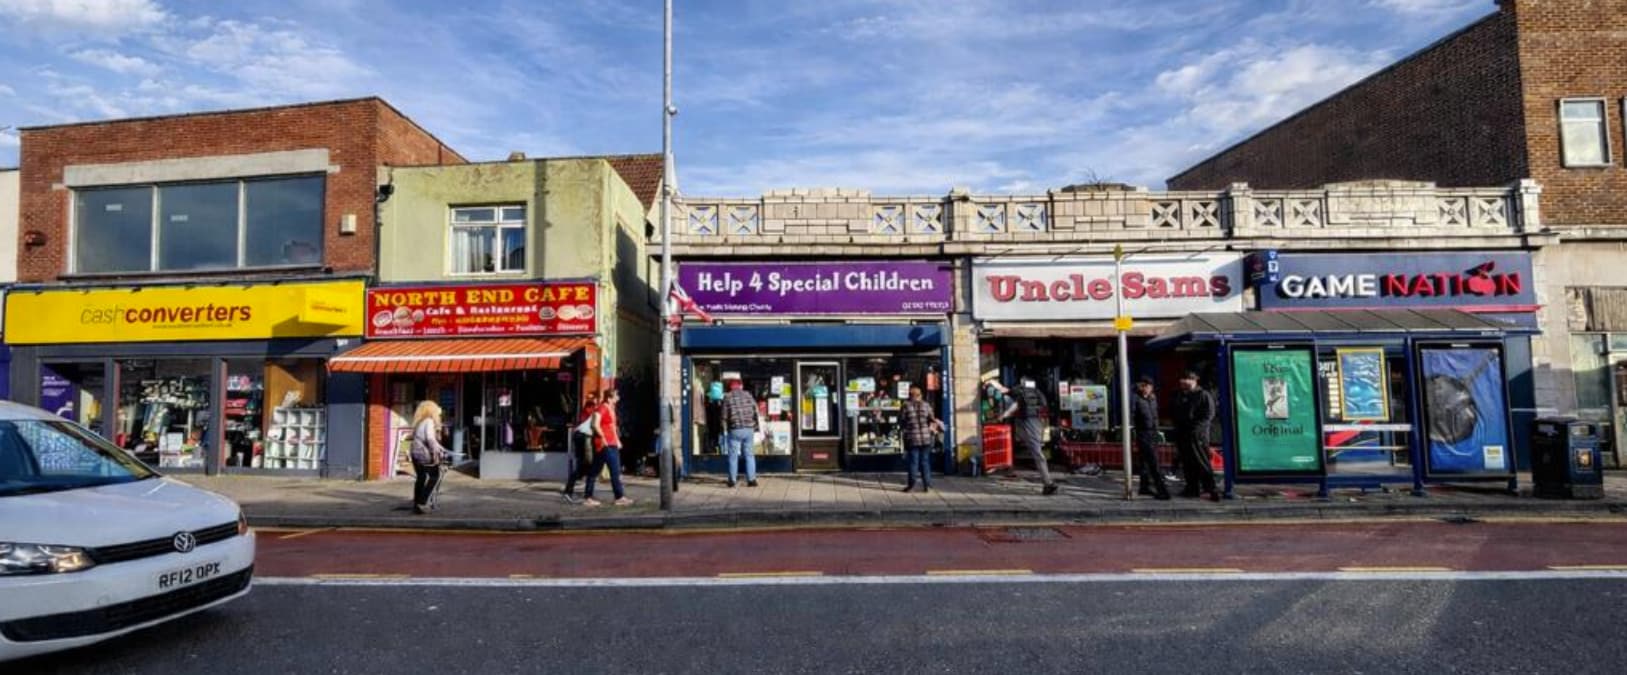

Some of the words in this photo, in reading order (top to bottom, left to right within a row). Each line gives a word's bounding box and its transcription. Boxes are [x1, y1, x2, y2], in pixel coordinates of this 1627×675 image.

[697, 271, 743, 297] Help
[748, 271, 764, 293] 4
[767, 271, 840, 297] Special
[844, 270, 934, 291] Children
[986, 273, 1114, 302] Uncle
[1120, 271, 1233, 302] Sams
[1281, 273, 1377, 298] GAME
[1382, 261, 1522, 298] NATION
[373, 290, 457, 308] NORTH
[466, 288, 515, 304] END
[523, 286, 590, 303] CAFE
[425, 306, 452, 316] Cafe
[455, 305, 465, 315] &
[469, 304, 538, 314] Restaurant
[1252, 423, 1304, 438] Original
[159, 568, 193, 589] RF12
